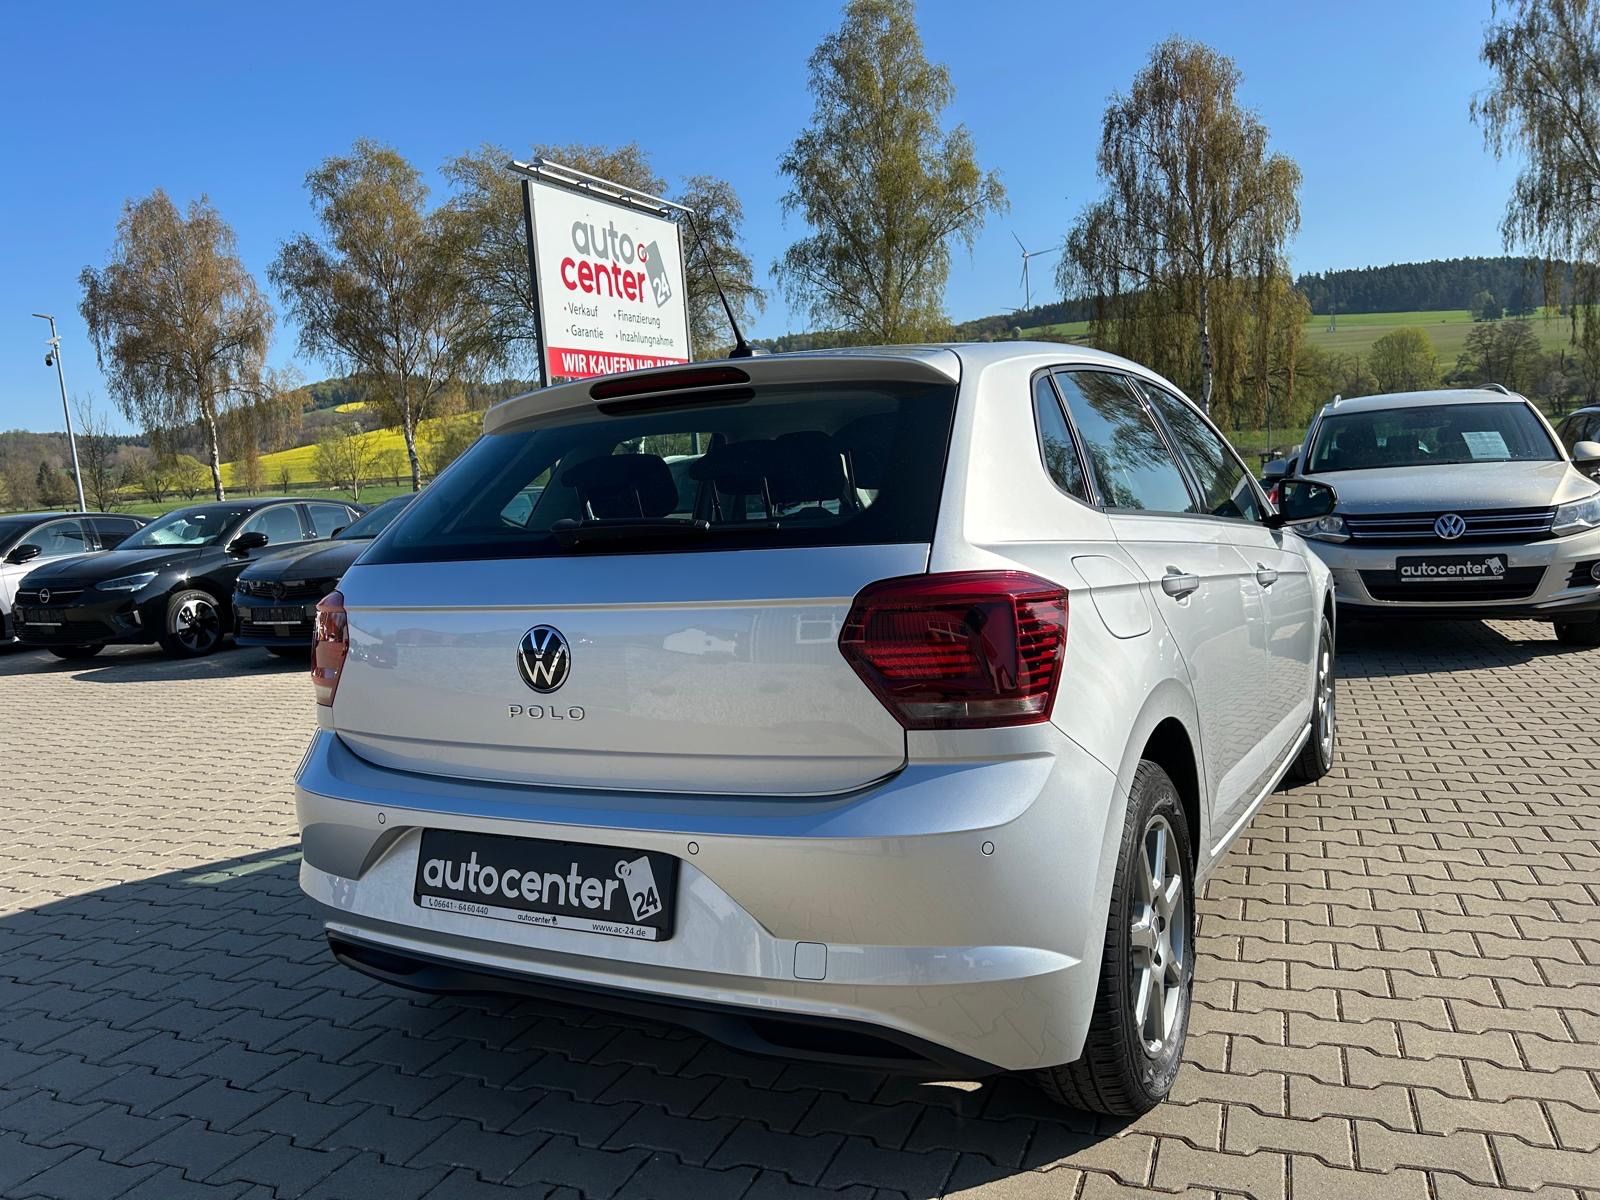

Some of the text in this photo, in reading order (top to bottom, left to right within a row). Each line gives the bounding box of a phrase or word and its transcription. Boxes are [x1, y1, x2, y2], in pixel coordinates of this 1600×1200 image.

[572, 221, 634, 264] auto
[561, 257, 646, 303] center
[654, 273, 670, 303] 24
[568, 302, 598, 318] Verkauf
[617, 309, 661, 329] Finanzierung
[571, 324, 604, 339] Garantie
[619, 330, 674, 347] Inzahlungnahme
[562, 352, 587, 373] WIR
[1401, 561, 1487, 576] autocenter
[508, 704, 585, 722] POLO
[423, 852, 658, 918] autocenter 24
[517, 913, 551, 925] autocenter
[592, 923, 647, 937] www.ac-24.de
